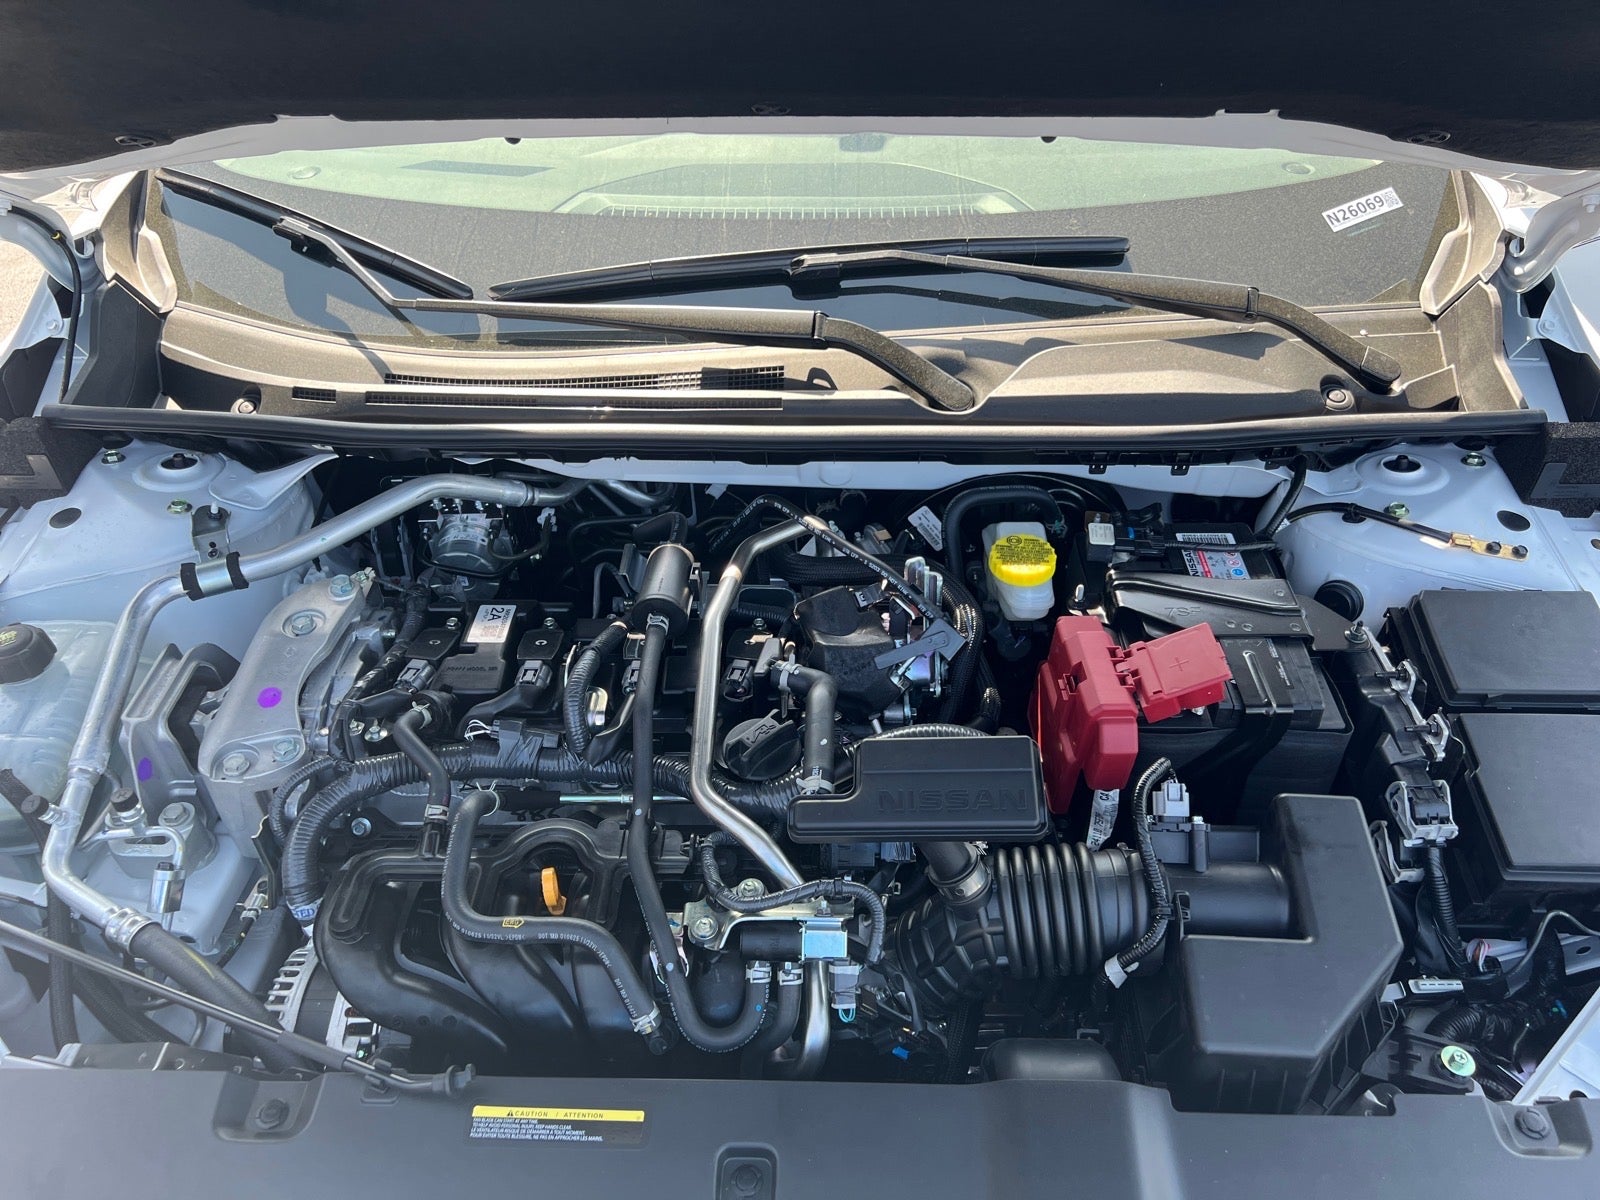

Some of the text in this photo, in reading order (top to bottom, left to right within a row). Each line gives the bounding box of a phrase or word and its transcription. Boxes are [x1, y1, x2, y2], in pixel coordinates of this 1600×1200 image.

[1326, 195, 1385, 226] N26069
[488, 607, 505, 621] 2A
[878, 789, 1028, 811] NISSAN
